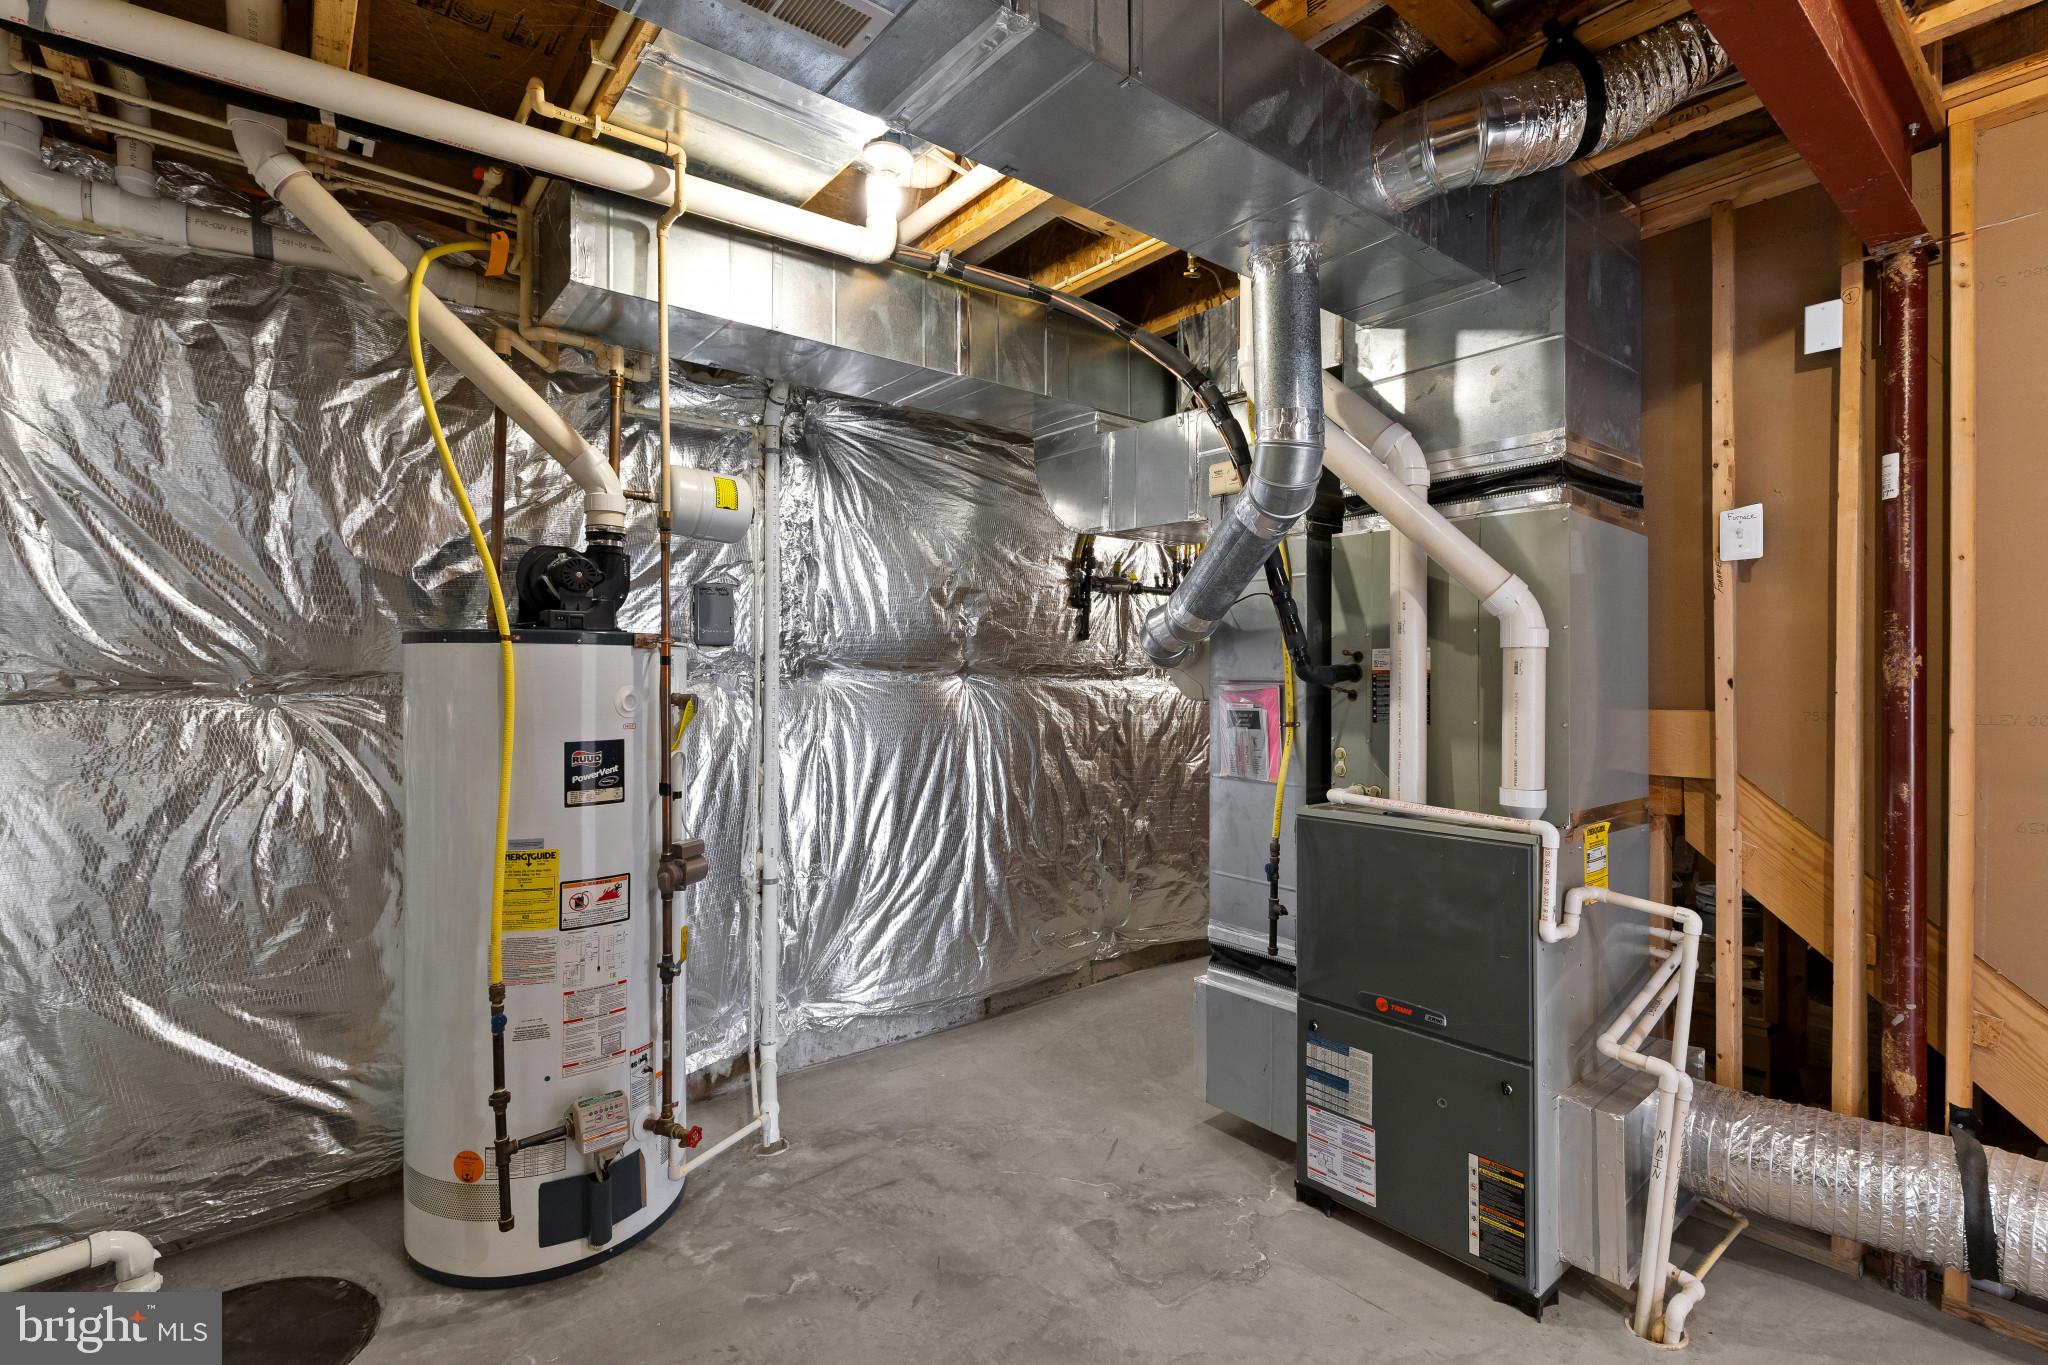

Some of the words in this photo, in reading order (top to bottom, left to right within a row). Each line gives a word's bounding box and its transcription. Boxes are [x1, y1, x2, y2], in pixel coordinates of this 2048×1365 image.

[230, 225, 249, 237] PIPE
[1727, 512, 1757, 521] Furnace
[572, 755, 602, 763] RUUD
[572, 765, 618, 784] PowerVent
[504, 852, 557, 862] NERGYGUIDE
[1652, 1129, 1667, 1179] MAIN
